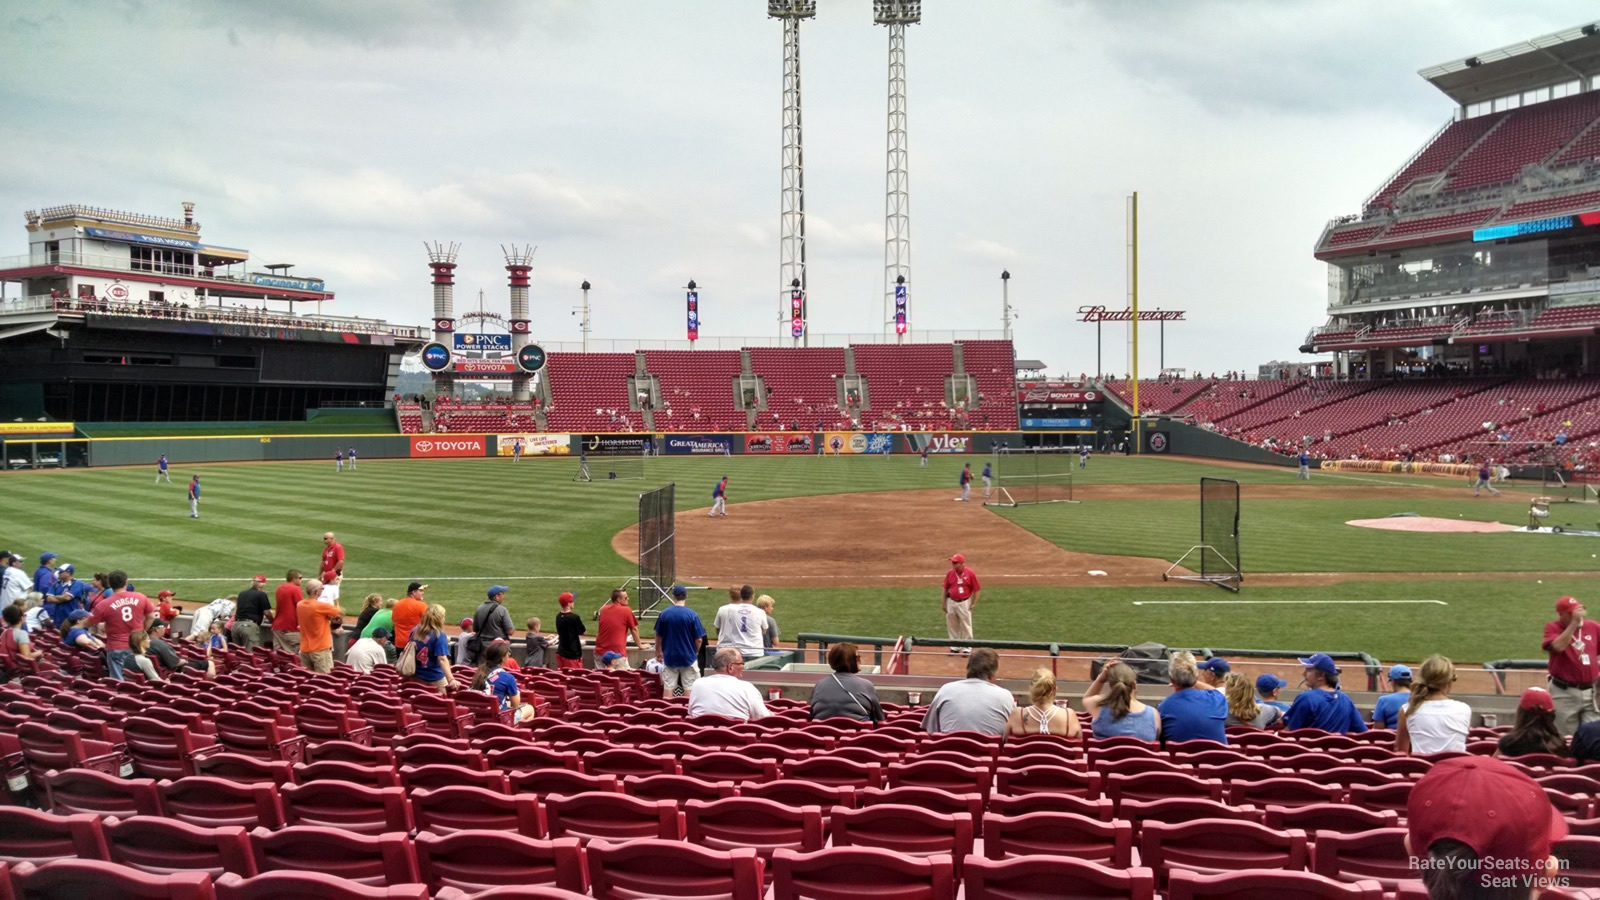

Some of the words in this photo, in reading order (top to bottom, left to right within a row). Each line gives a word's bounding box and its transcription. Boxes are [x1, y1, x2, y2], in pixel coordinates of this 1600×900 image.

[141, 235, 164, 243] PILOT
[165, 239, 193, 247] HOUSE
[254, 275, 304, 289] Cincinnati
[307, 279, 325, 291] Bell
[1079, 305, 1184, 322] Budweiser
[476, 335, 502, 345] PNC
[435, 442, 480, 450] TOYOTA
[110, 598, 140, 610] MORGAN
[121, 606, 133, 622] 8
